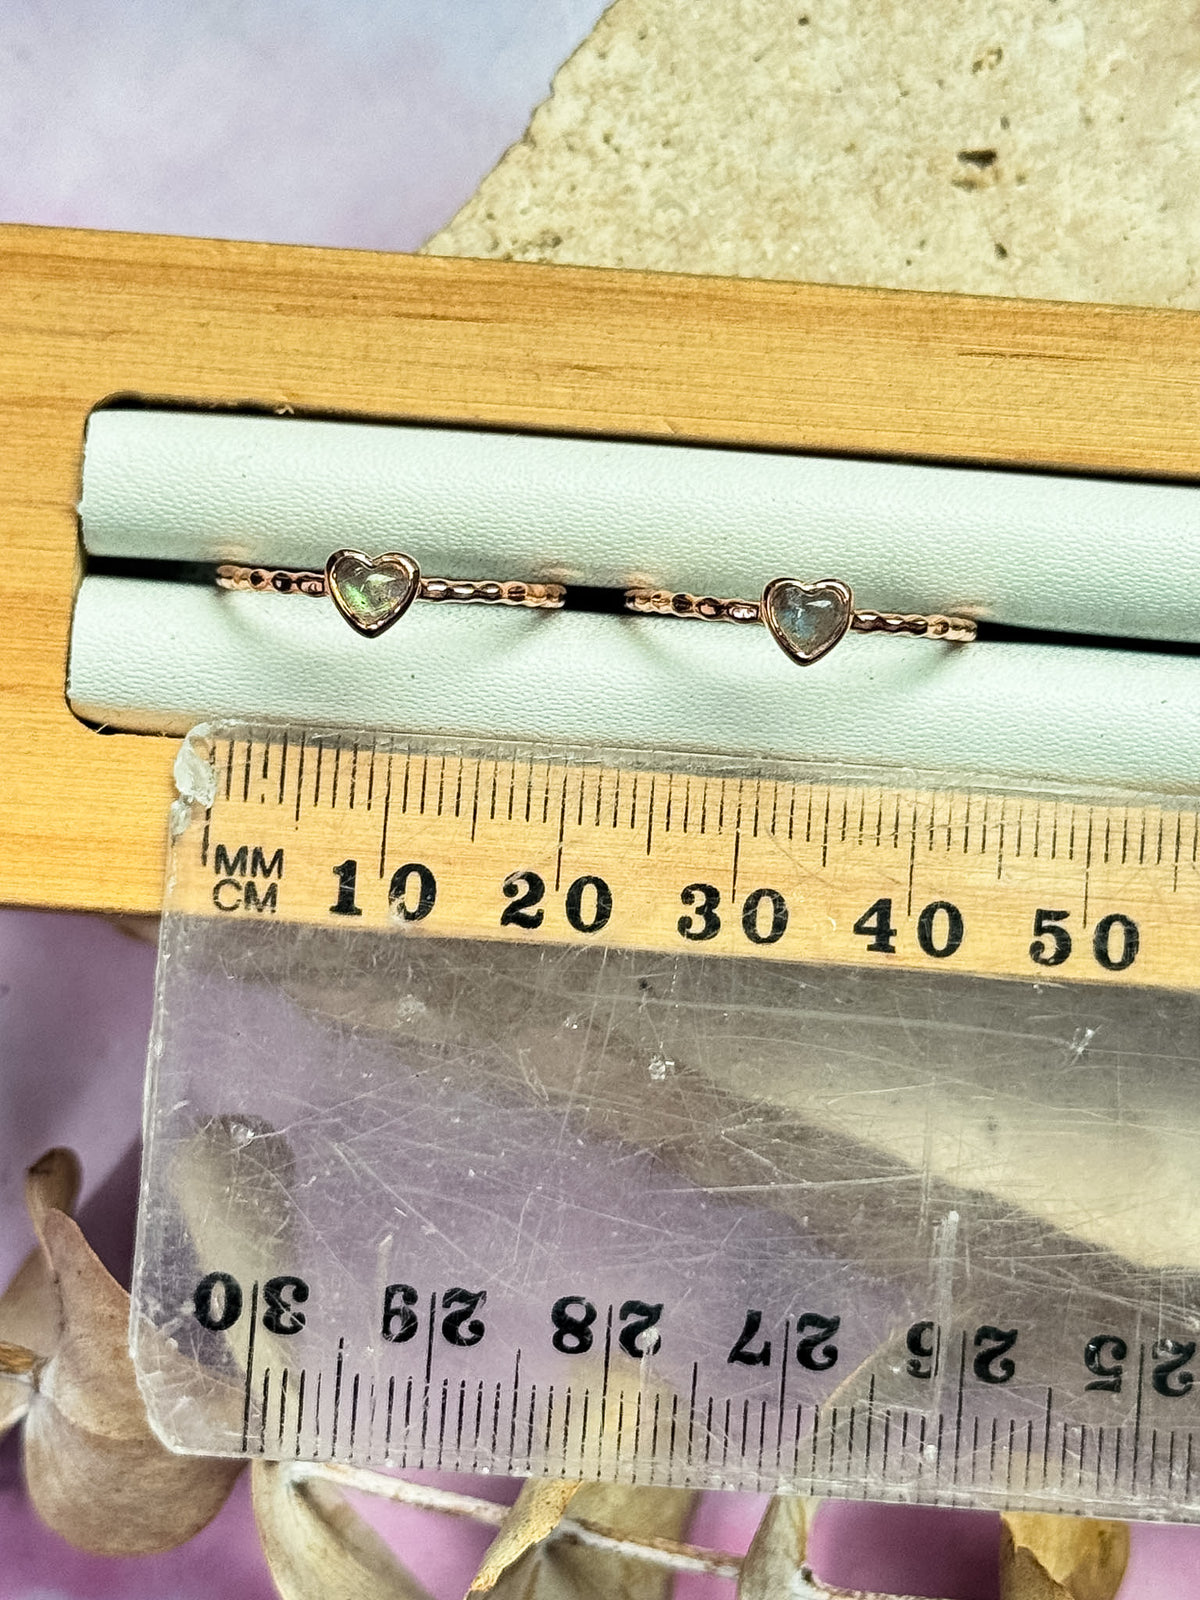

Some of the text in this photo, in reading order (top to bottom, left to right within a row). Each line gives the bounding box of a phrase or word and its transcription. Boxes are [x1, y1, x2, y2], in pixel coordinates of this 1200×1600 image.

[214, 844, 285, 879] MM
[213, 878, 279, 913] CM
[329, 859, 1140, 971] 10 20 30 40 50
[194, 1271, 309, 1335] 30
[381, 1284, 487, 1346] 29
[551, 1296, 664, 1358] 28
[728, 1309, 840, 1371] 27
[1084, 1334, 1196, 1397] 25
